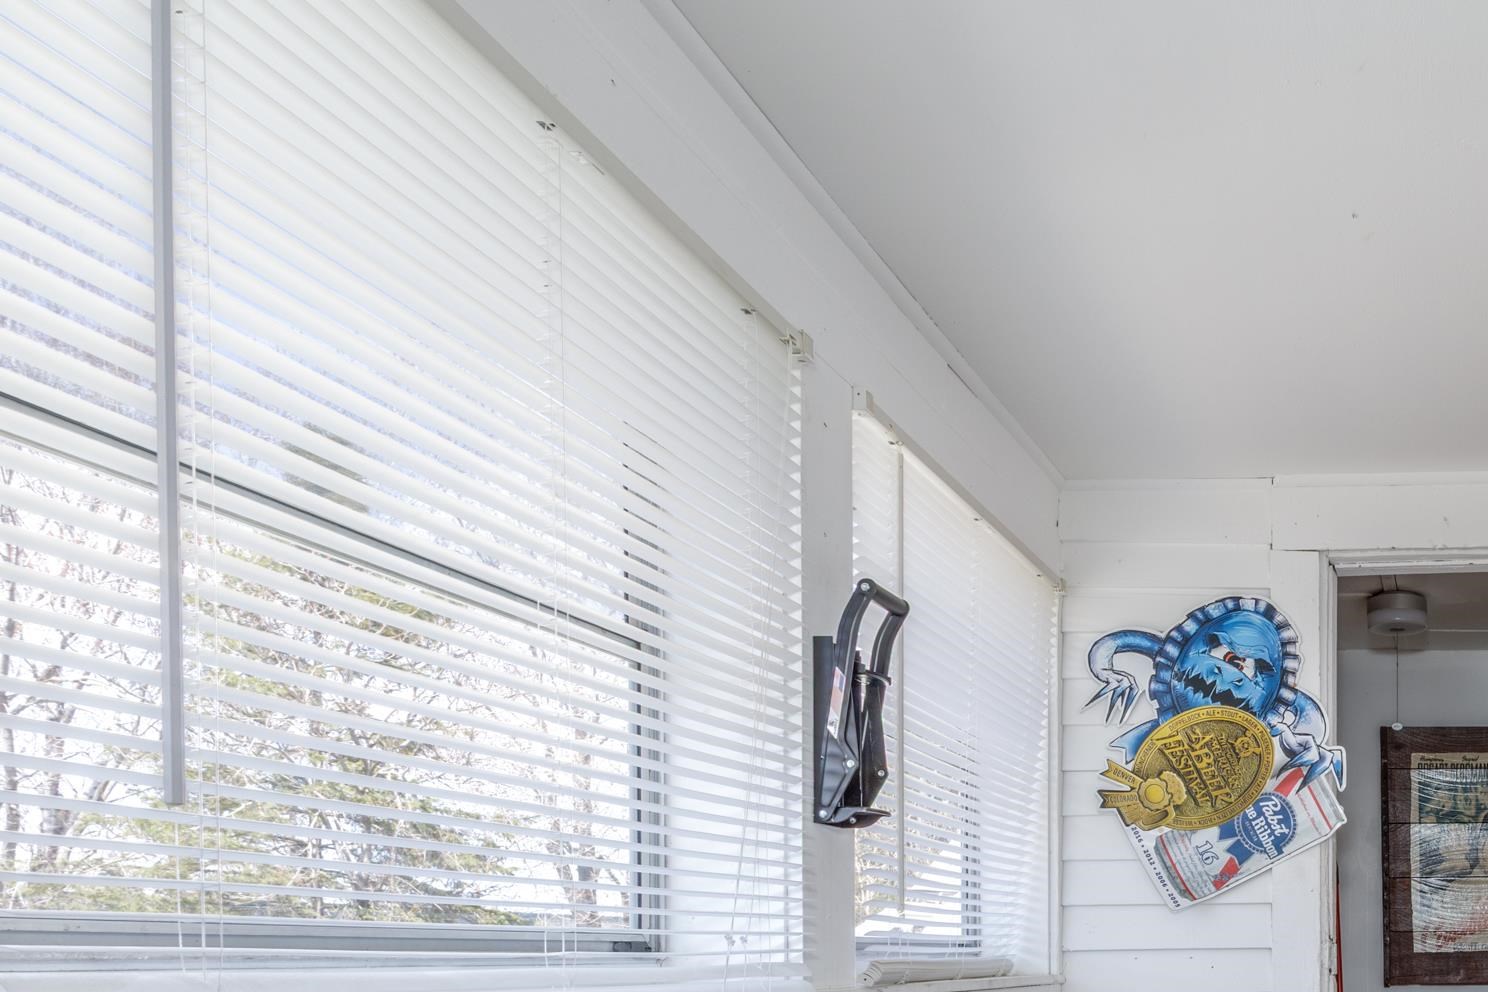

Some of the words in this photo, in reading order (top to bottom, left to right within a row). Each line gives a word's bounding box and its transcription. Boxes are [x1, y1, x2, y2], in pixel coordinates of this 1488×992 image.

[1220, 710, 1239, 719] STOUT
[1241, 715, 1257, 731] LAGER
[1112, 768, 1136, 784] DENVER
[1155, 728, 1212, 808] FESTIVAL
[1191, 745, 1234, 808] BEER
[1260, 795, 1290, 836] Pabst
[1131, 826, 1144, 844] 2016
[1143, 849, 1156, 867] 2012
[1196, 840, 1220, 866] 16
[1252, 816, 1279, 860] Ribbon
